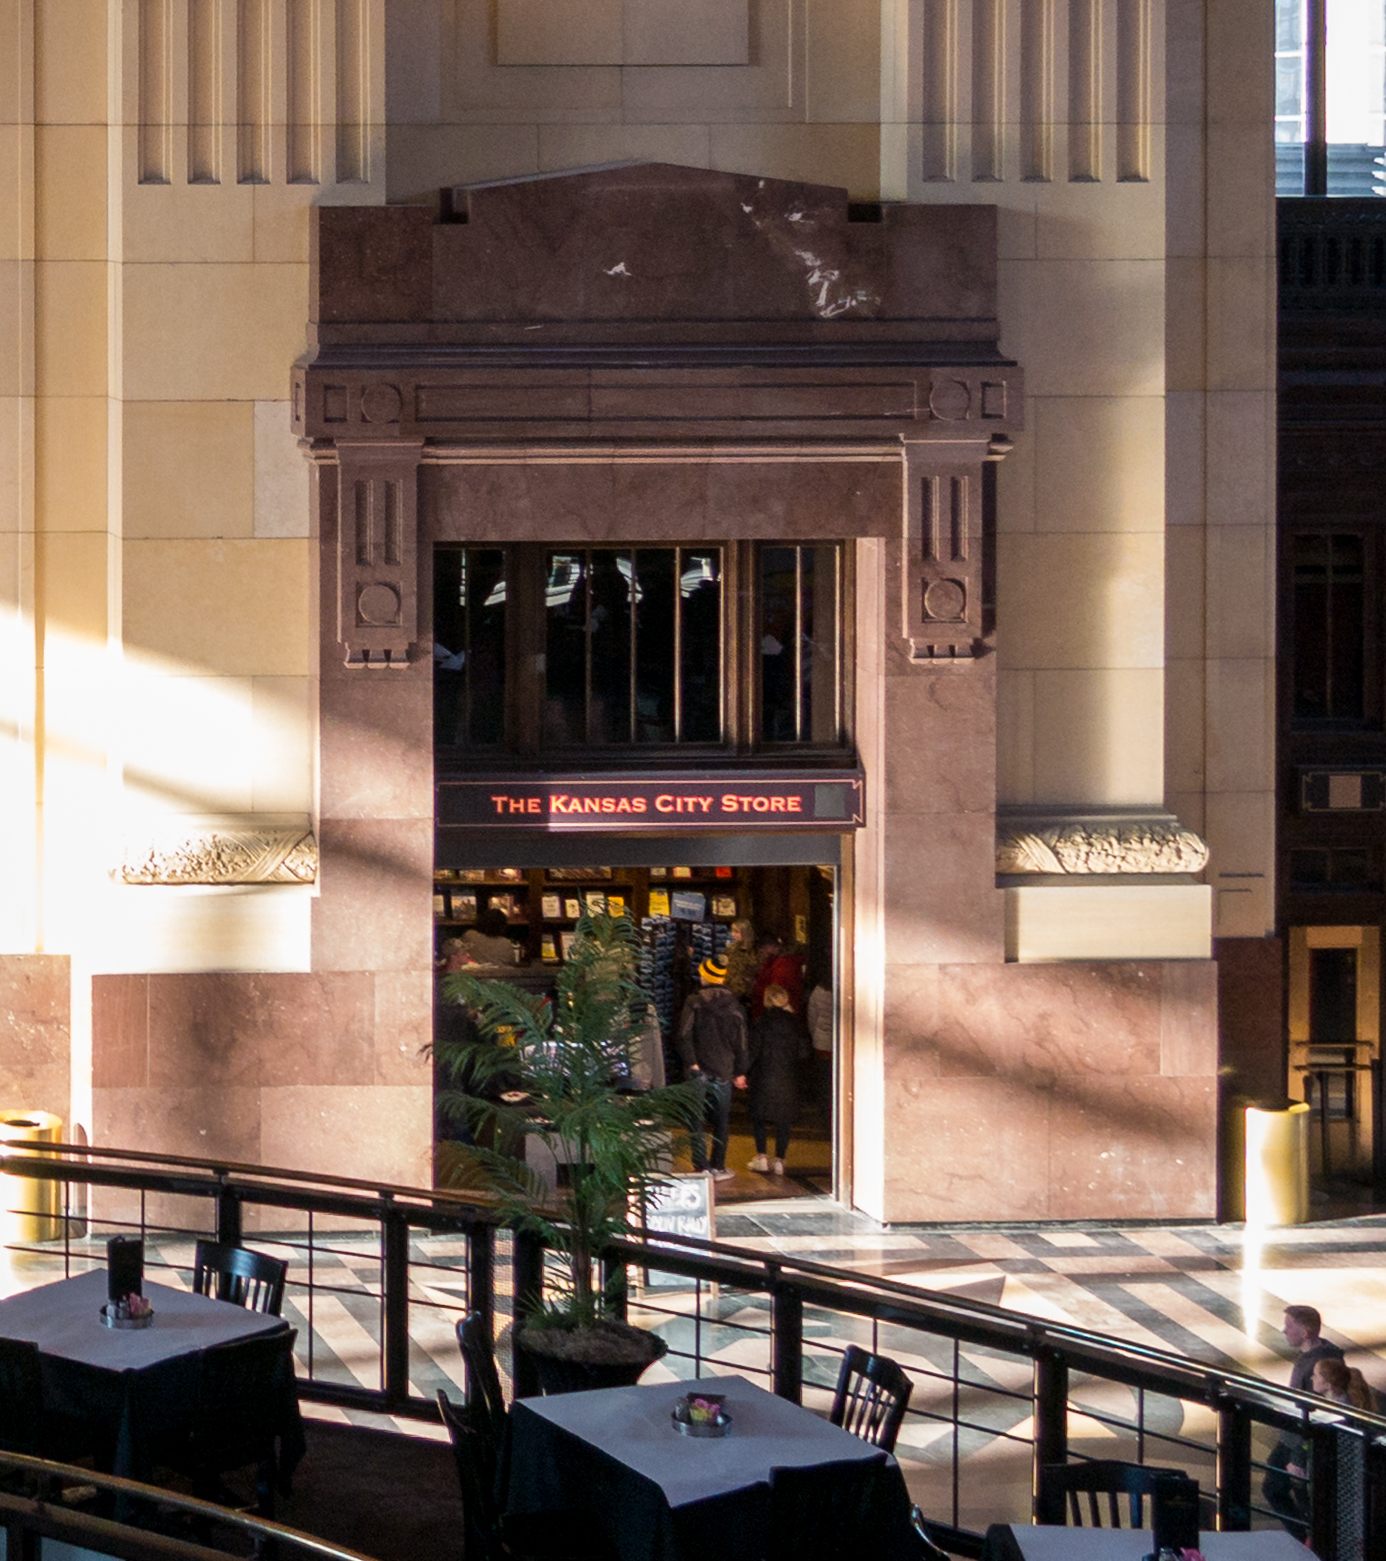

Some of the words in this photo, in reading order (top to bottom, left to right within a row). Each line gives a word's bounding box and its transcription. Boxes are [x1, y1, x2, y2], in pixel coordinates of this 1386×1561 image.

[491, 795, 542, 814] THE
[549, 794, 647, 814] KANSAS
[655, 793, 714, 814] CITY
[721, 793, 803, 814] STORE
